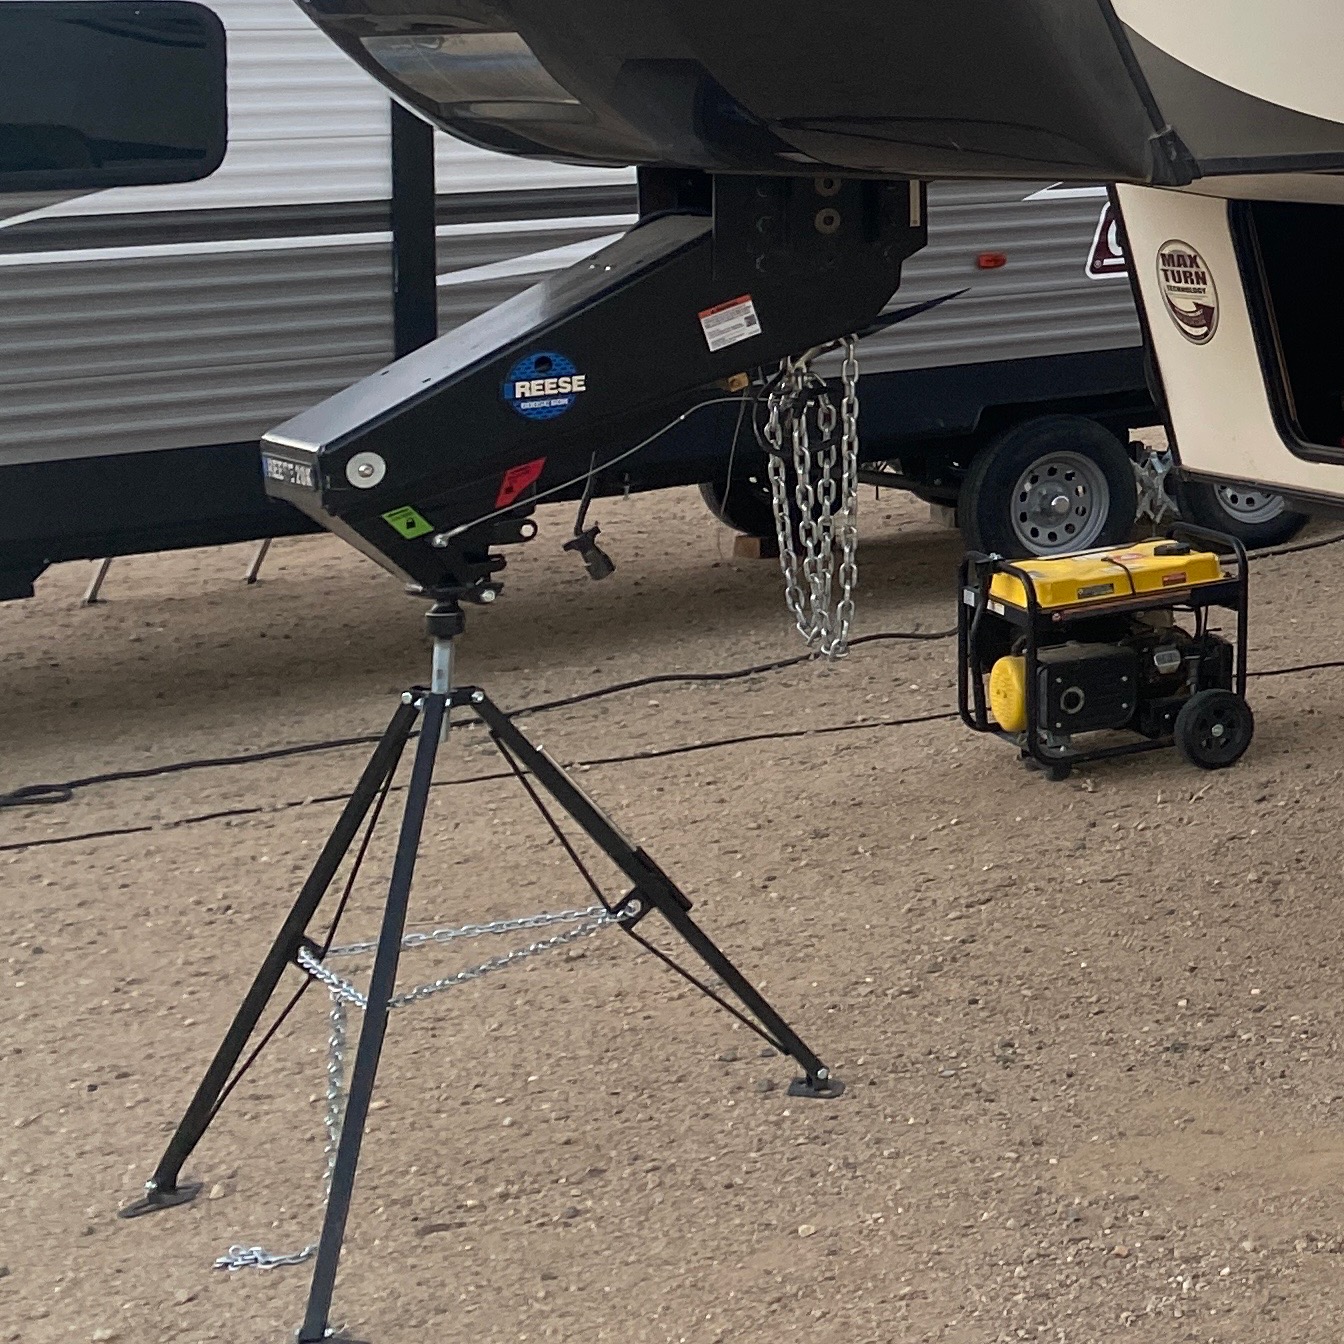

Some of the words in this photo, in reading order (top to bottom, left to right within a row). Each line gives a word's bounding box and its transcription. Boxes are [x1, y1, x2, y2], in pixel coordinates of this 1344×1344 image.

[1160, 252, 1201, 269] MAX
[1160, 267, 1208, 286] TURN
[515, 374, 587, 399] REESE
